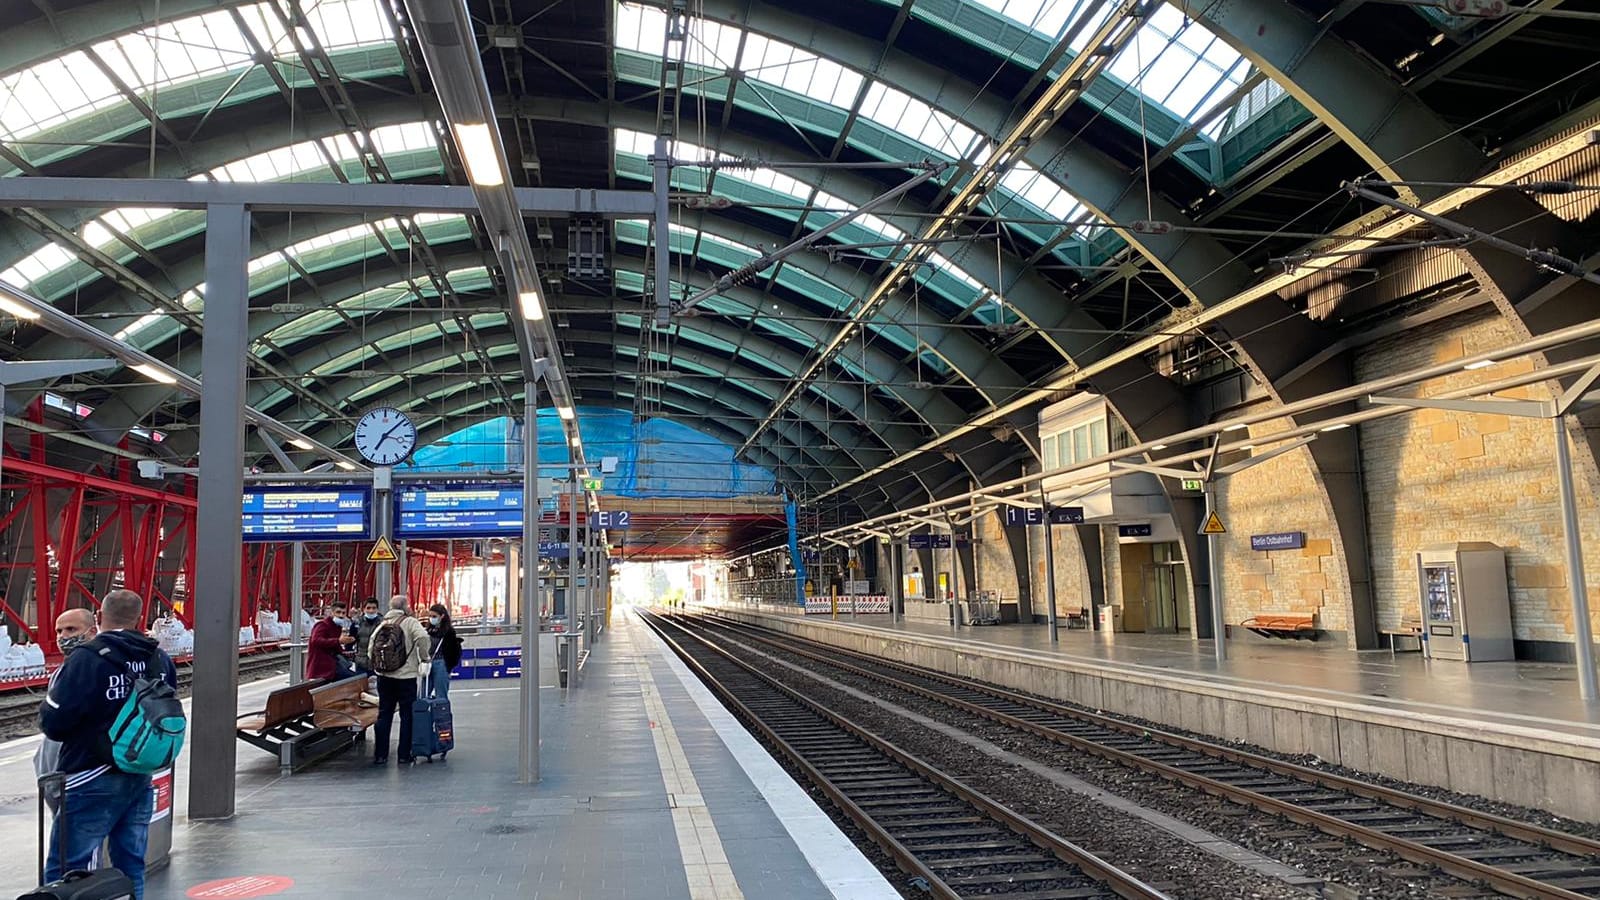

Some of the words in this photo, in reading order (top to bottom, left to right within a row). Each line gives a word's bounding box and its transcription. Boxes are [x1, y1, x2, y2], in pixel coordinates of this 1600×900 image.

[598, 511, 609, 526] E
[618, 511, 629, 525] 2
[1008, 508, 1016, 522] 1
[1027, 508, 1036, 521] E
[1252, 536, 1266, 546] Berlin
